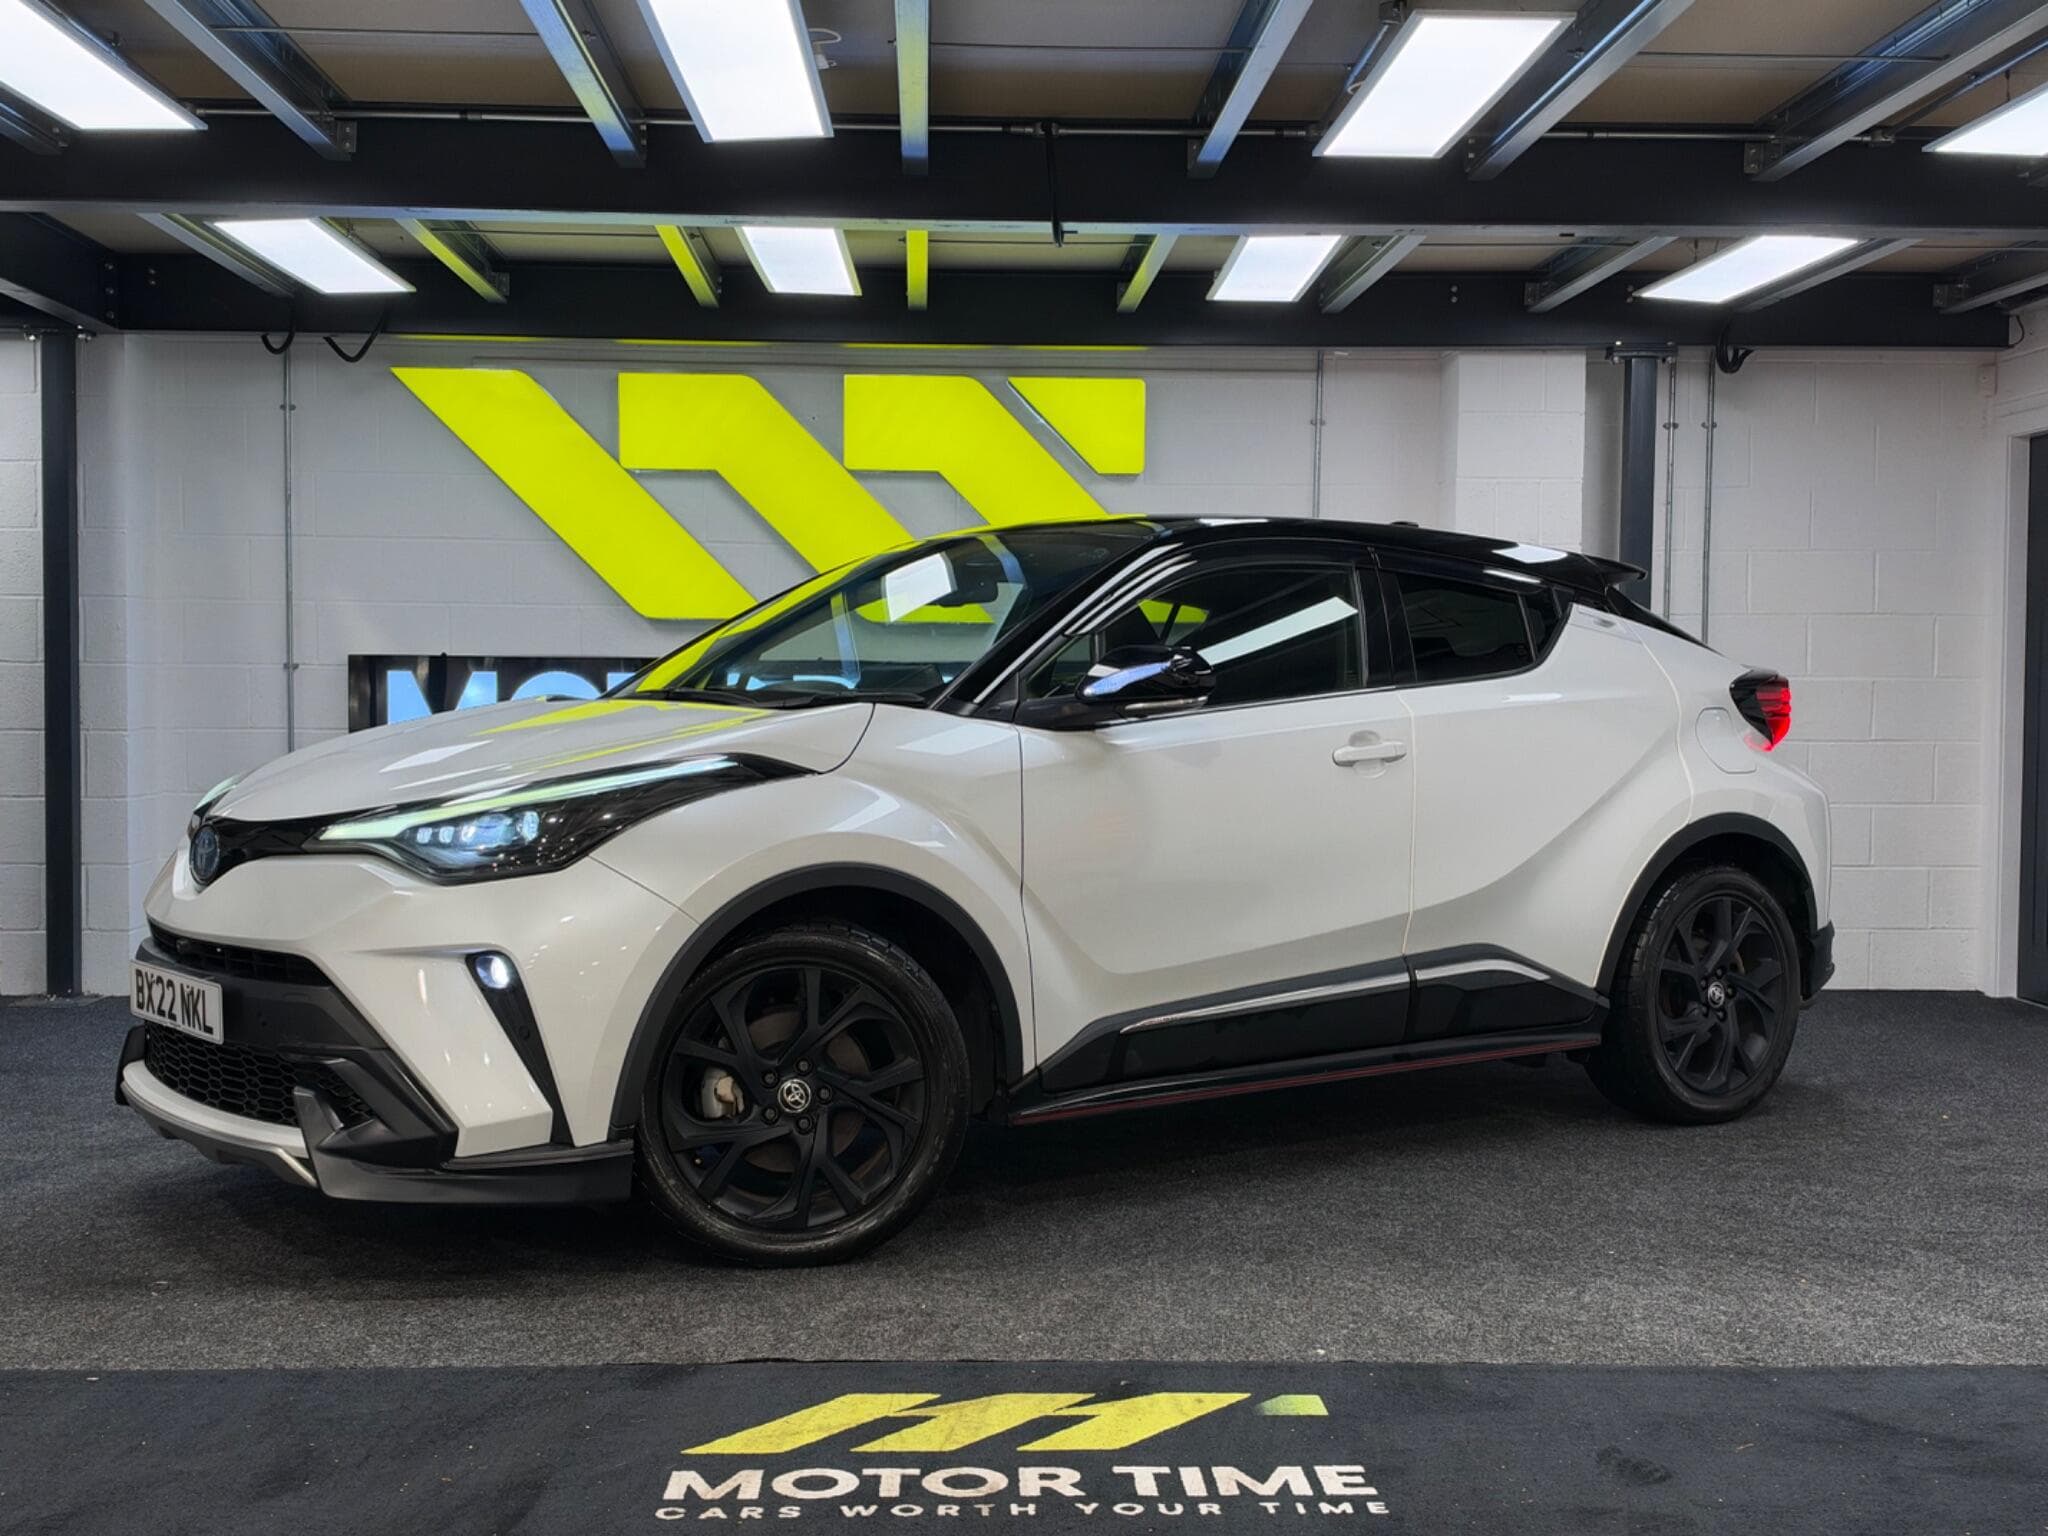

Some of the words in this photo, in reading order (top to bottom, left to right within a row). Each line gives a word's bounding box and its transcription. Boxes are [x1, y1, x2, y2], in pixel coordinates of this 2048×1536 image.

[135, 968, 177, 1022] BX22
[180, 982, 214, 1035] NKL
[662, 1465, 1086, 1500] MOTOR
[1112, 1464, 1379, 1497] TIME
[654, 1505, 802, 1521] CARS
[839, 1502, 1037, 1518] WORTH
[1074, 1502, 1223, 1516] YOUR
[1258, 1501, 1390, 1515] TIME
